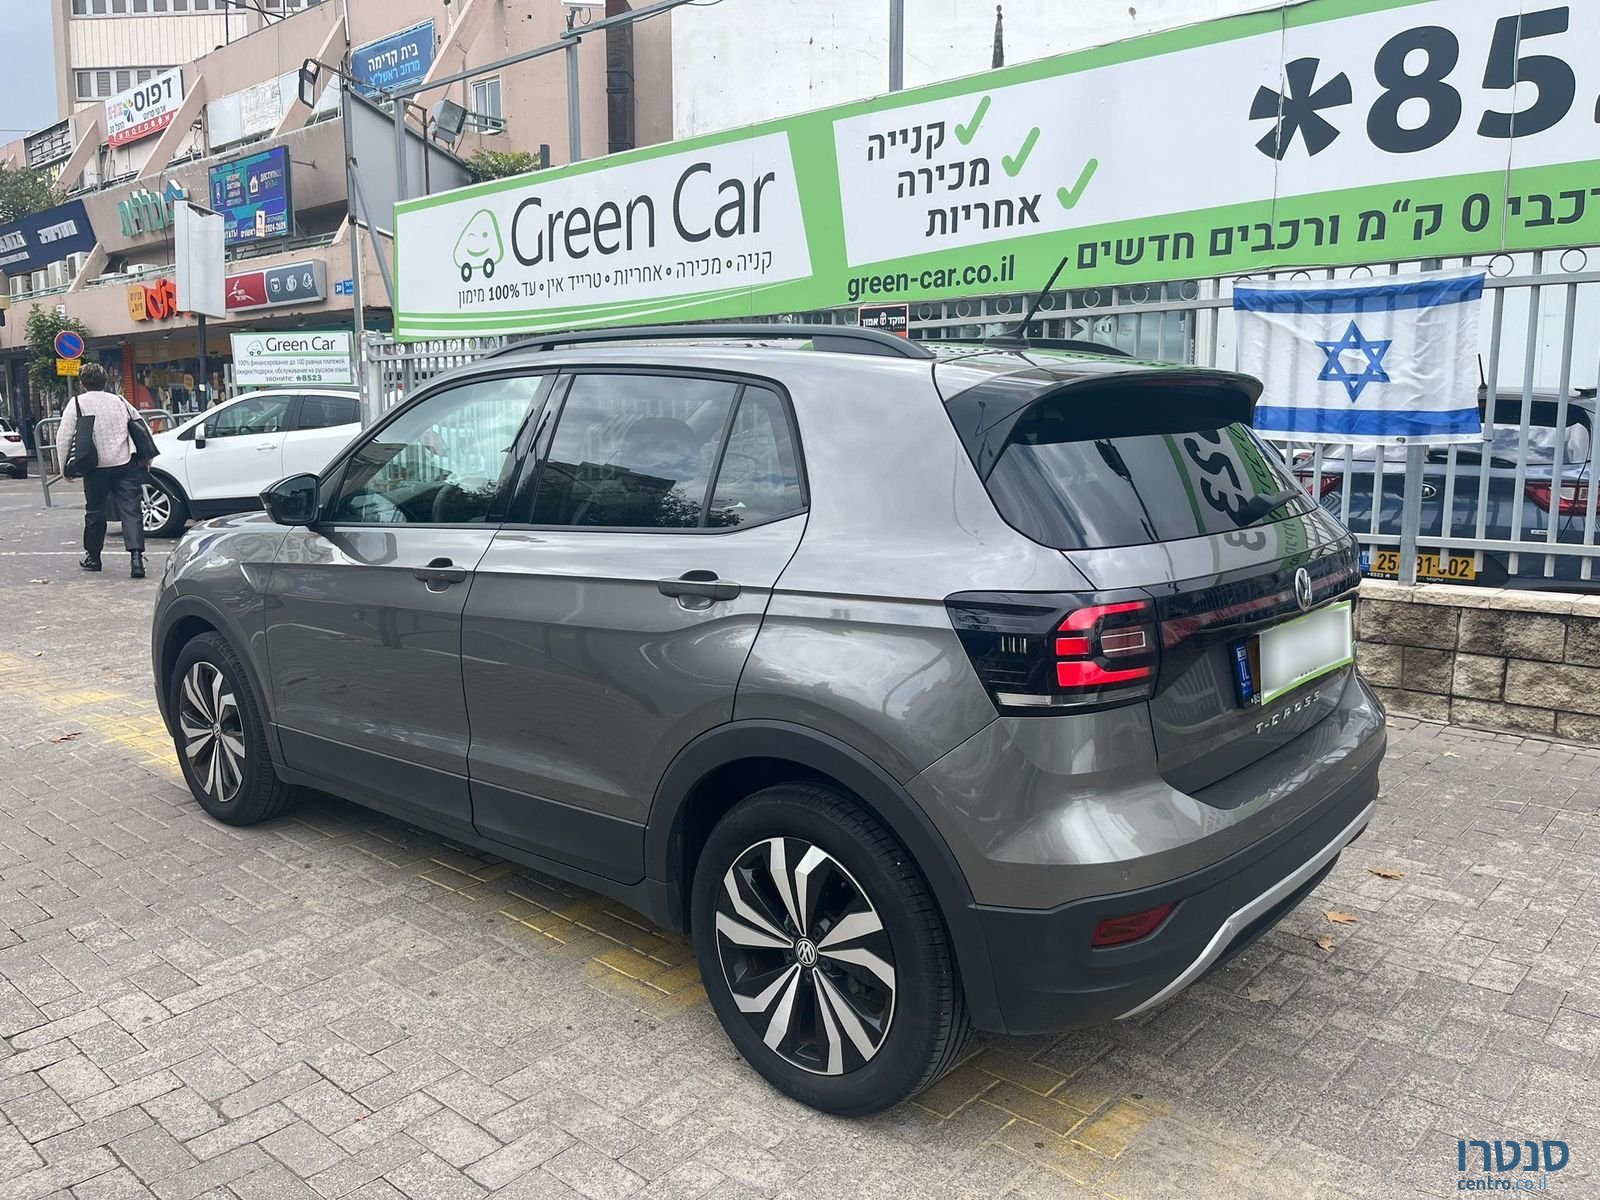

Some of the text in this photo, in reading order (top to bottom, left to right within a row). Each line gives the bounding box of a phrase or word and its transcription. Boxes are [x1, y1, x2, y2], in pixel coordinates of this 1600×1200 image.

[401, 43, 418, 60] בית
[133, 77, 172, 112] דפוס
[1249, 6, 1600, 161] 85
[867, 121, 946, 161] קנייה
[897, 157, 990, 198] מכירה
[511, 162, 775, 267] Green Car
[925, 194, 1042, 237] אחריות
[1461, 193, 1491, 232] 0
[1508, 188, 1600, 227] כבי
[1077, 231, 1195, 270] חדשים
[1209, 215, 1340, 257] ורכבים
[458, 250, 772, 309] קניה מכירה אחריות טרייד אין עד 100% מימון
[847, 254, 1015, 301] green-car.co.il
[888, 316, 906, 327] מוקד
[266, 336, 336, 352] Green Car
[1255, 690, 1321, 735] T-CROSS
